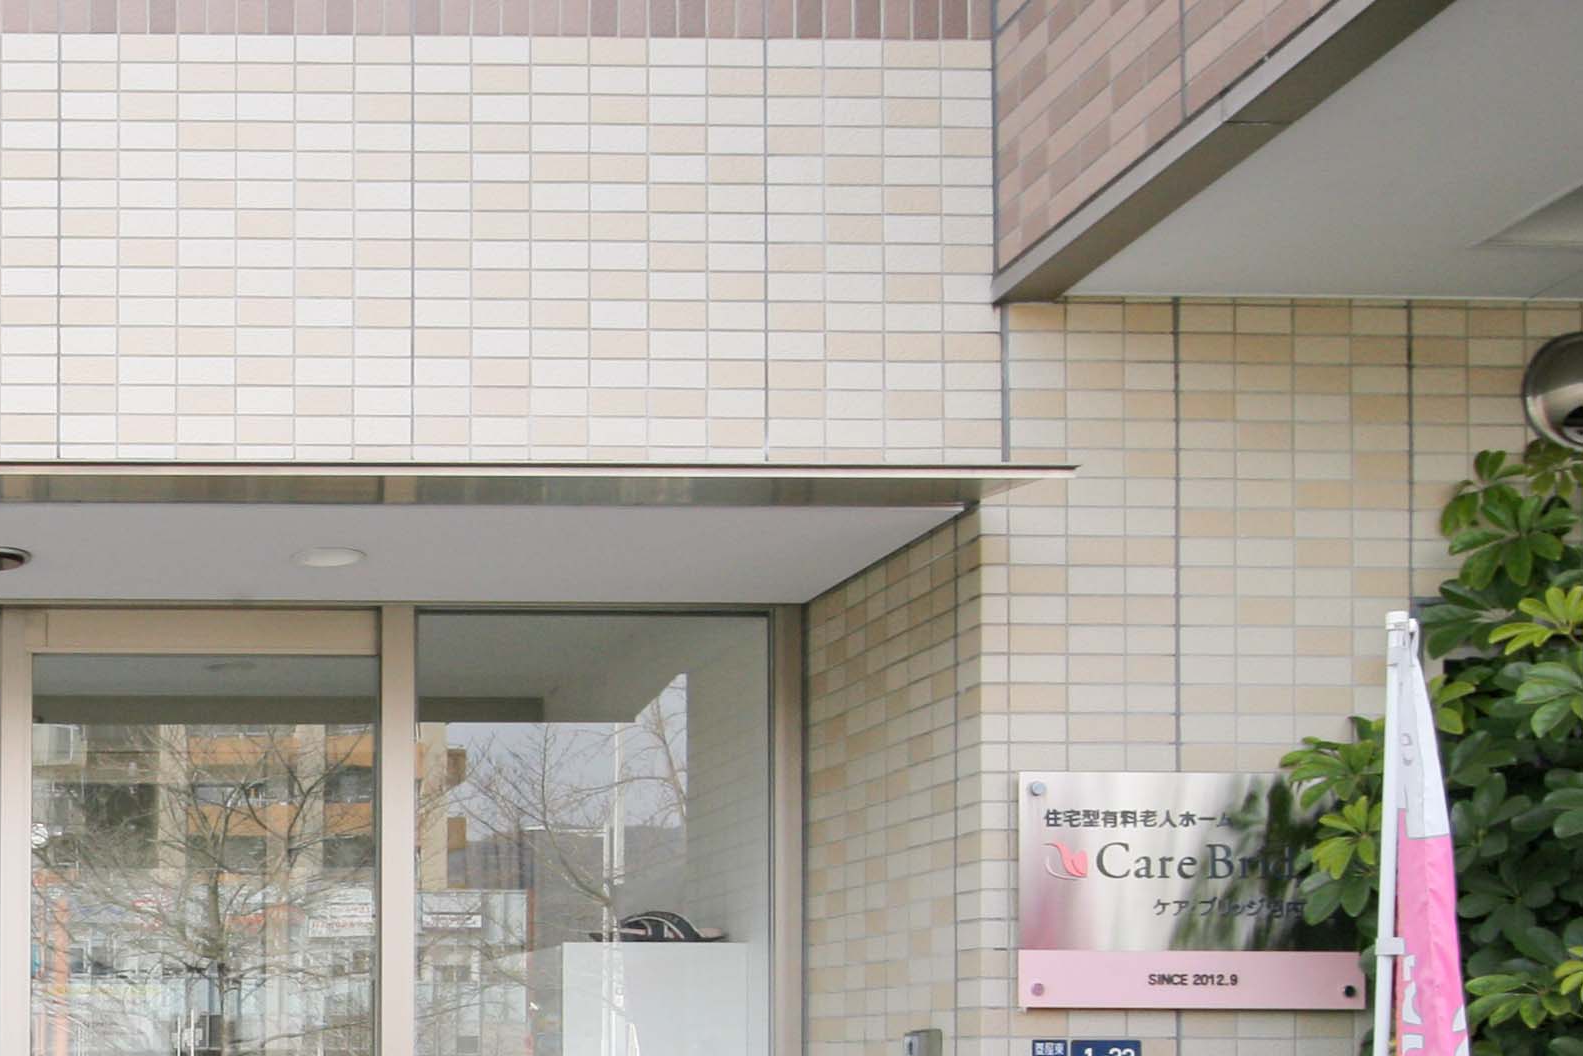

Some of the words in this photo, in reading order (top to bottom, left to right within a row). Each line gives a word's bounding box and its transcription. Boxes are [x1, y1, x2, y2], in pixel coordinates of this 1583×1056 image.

[1044, 809, 1234, 828] 住宅型有料老人ホーム
[1096, 842, 1198, 879] Care
[1206, 843, 1298, 880] Brid
[1148, 974, 1189, 986] SINCE
[1192, 974, 1239, 986] 2012.9
